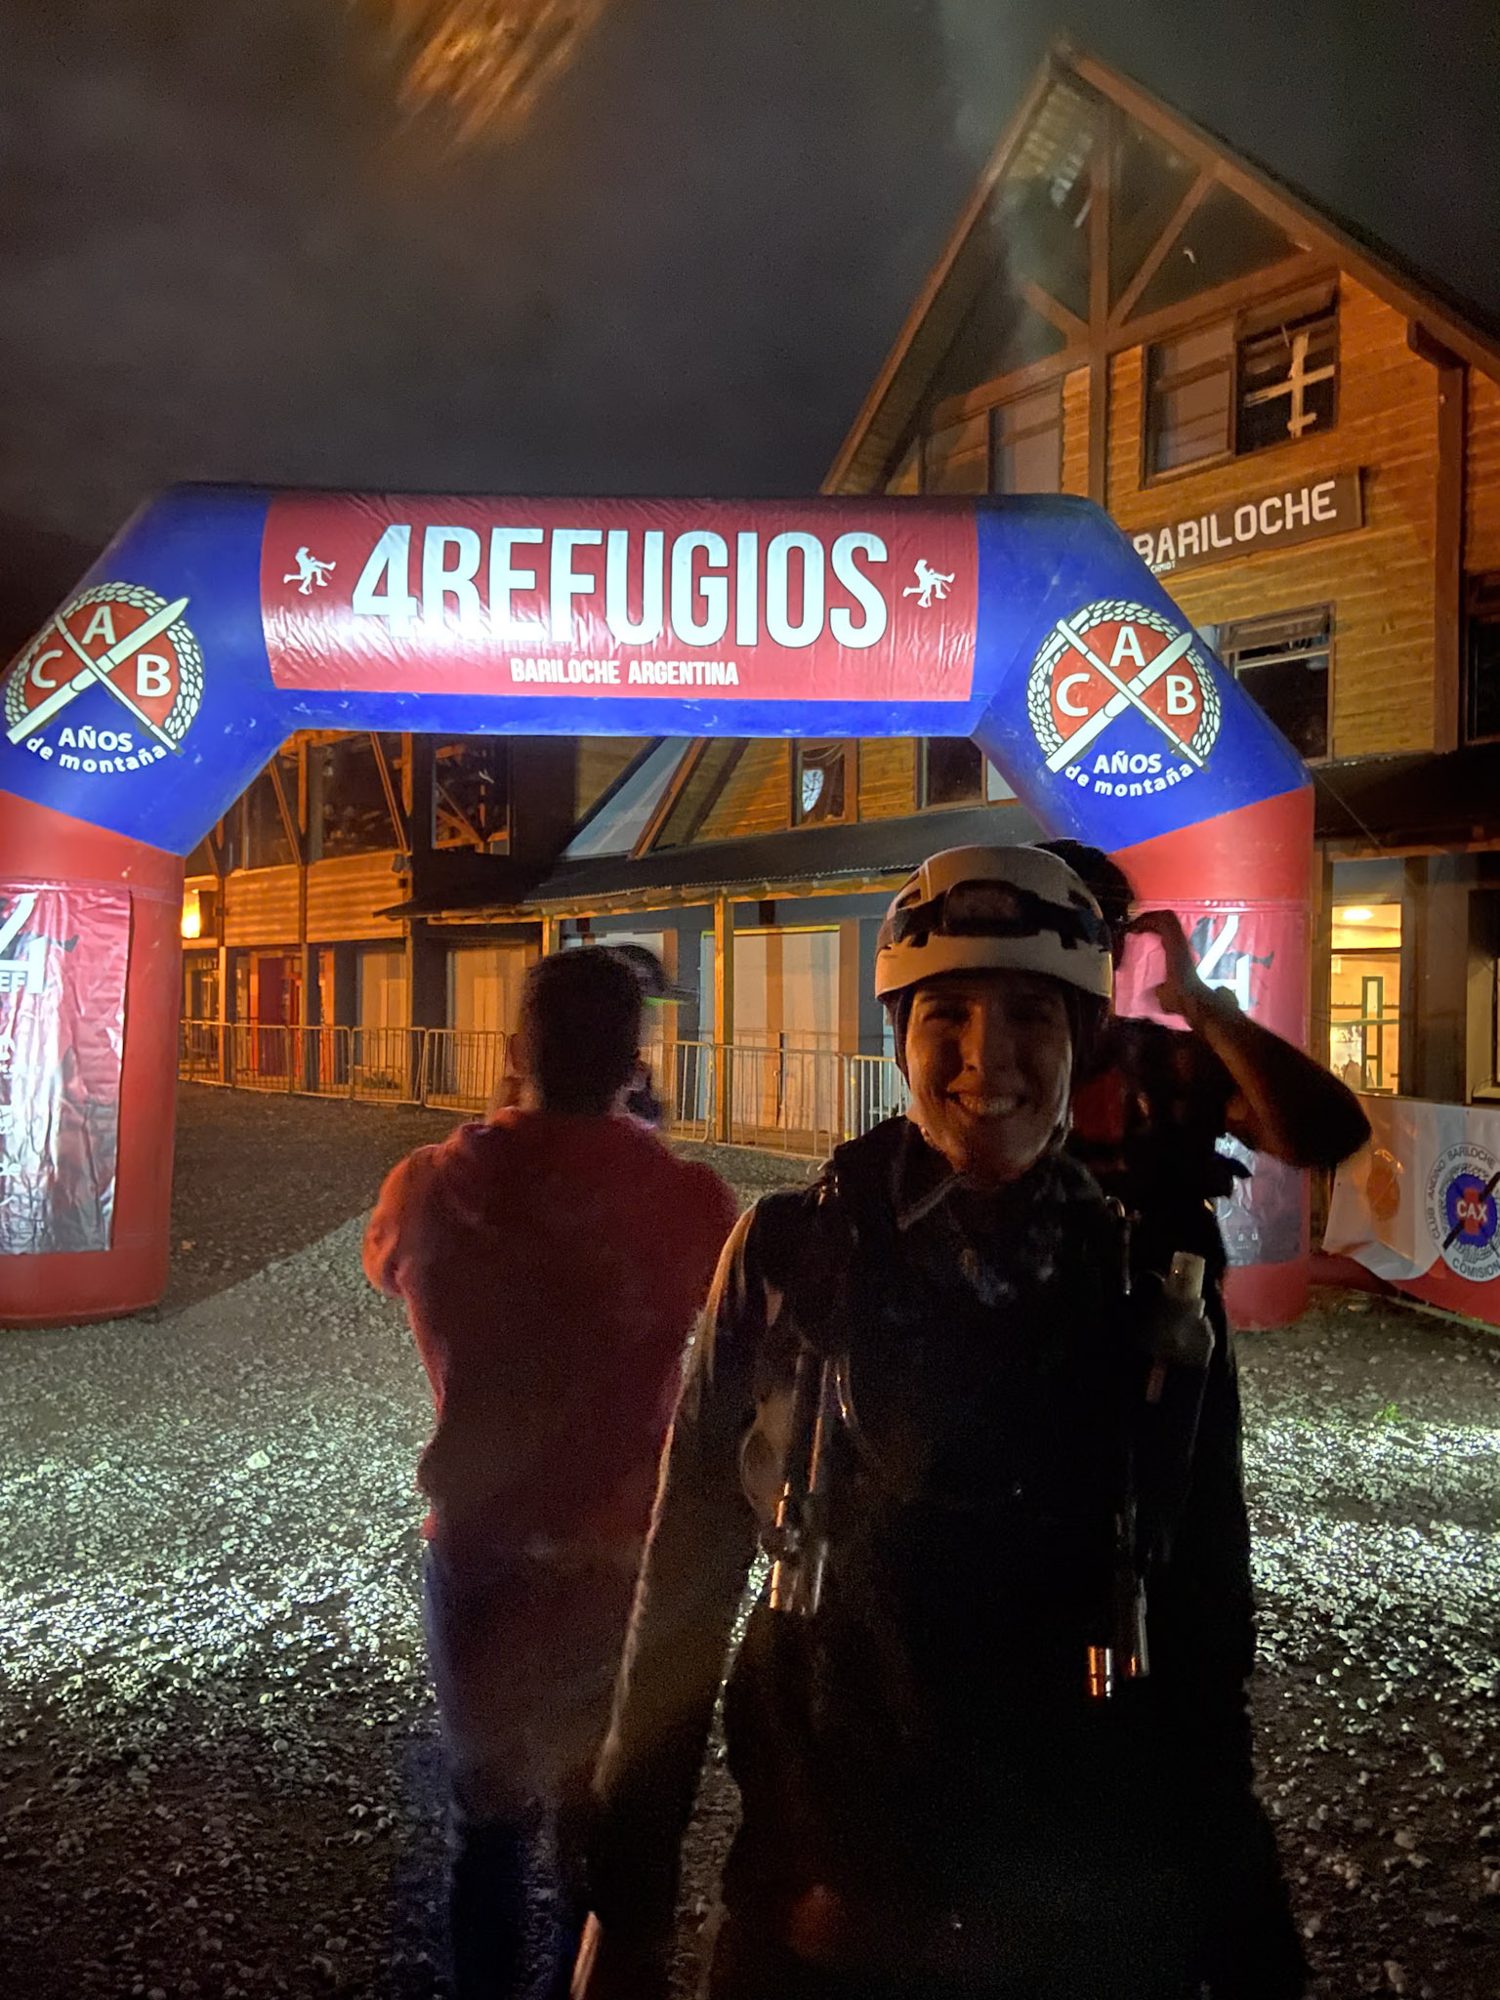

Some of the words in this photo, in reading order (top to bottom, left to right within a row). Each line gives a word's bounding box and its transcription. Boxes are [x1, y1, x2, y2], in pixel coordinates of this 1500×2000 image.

[1133, 480, 1337, 567] BARILOCHE
[351, 524, 889, 650] 4REFUGIOS
[510, 658, 620, 684] BARILOCHE
[627, 660, 740, 685] ARGENTINA
[58, 726, 133, 752] AÑOS
[26, 737, 53, 760] de
[59, 745, 167, 773] montaña
[1093, 750, 1162, 774] AÑOS
[1064, 764, 1089, 787] de
[1094, 763, 1194, 797] montaña
[1447, 1146, 1496, 1169] BARILOCHE
[1456, 1200, 1488, 1222] CAX
